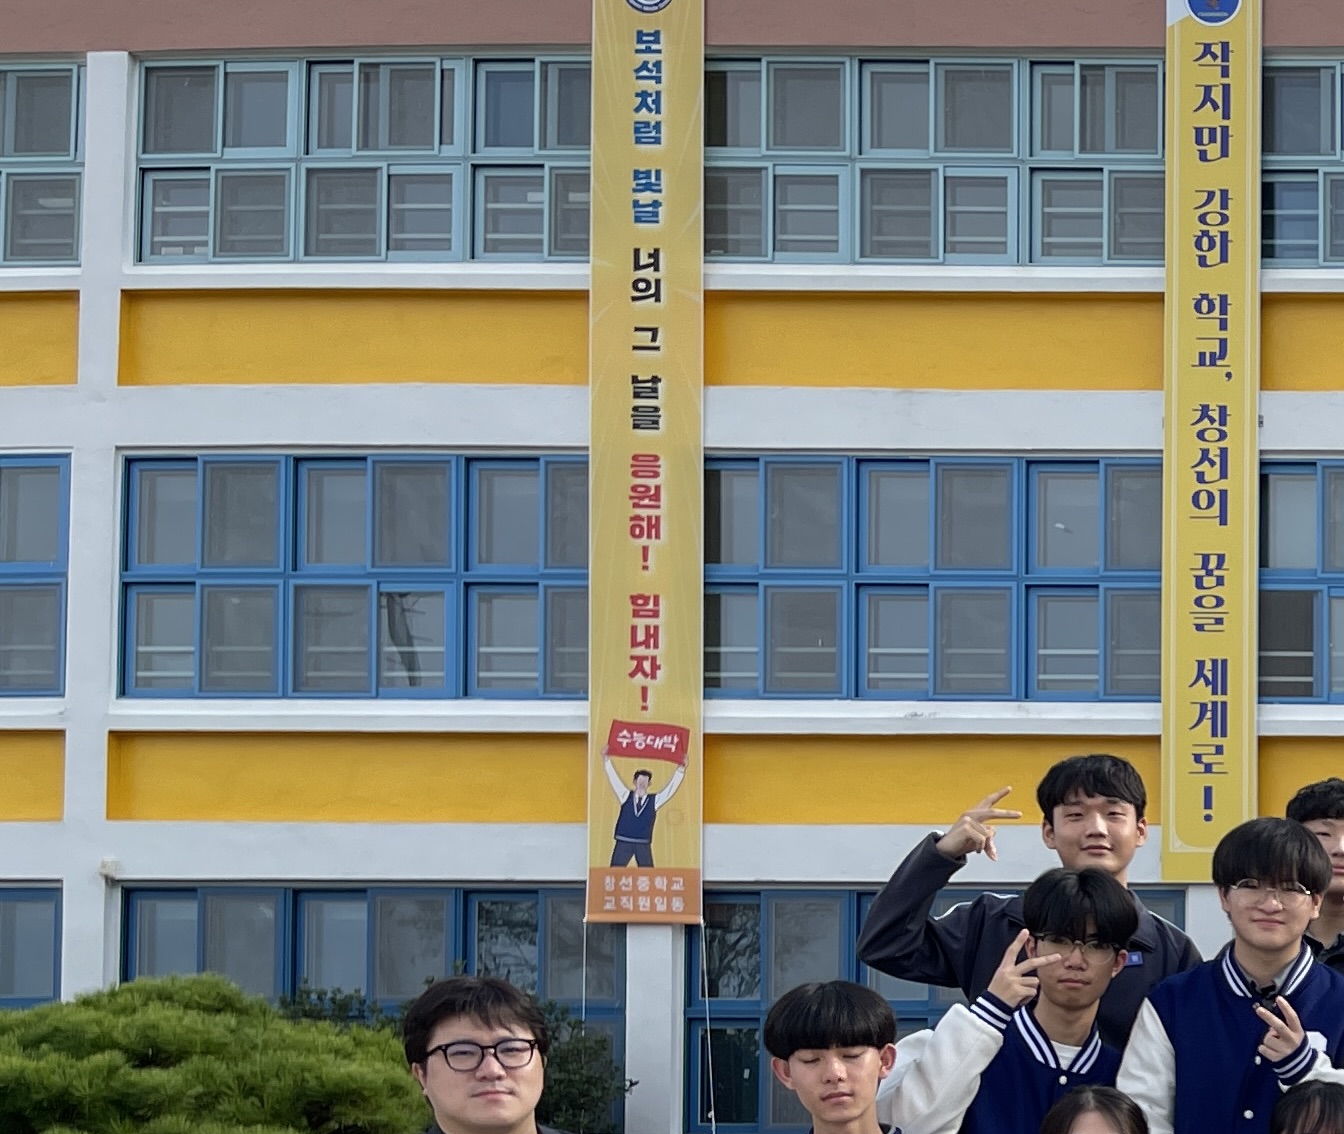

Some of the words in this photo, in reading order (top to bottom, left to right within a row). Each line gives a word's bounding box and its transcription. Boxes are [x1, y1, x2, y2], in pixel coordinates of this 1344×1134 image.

[633, 29, 662, 146] 보석처럼
[1193, 40, 1234, 163] 작지만
[632, 169, 662, 224] 빛날
[1192, 188, 1233, 268] 강한
[631, 247, 661, 303] 너의
[632, 326, 661, 352] 그
[1190, 293, 1233, 382] 학교,
[631, 374, 662, 431] 날을
[1189, 403, 1231, 526] 창선의
[629, 453, 661, 571] 응원해!
[1189, 552, 1229, 632] 꿈을
[629, 592, 661, 712] 힘내자!
[617, 728, 680, 753] 수능대박
[1188, 658, 1229, 822] 세계로!
